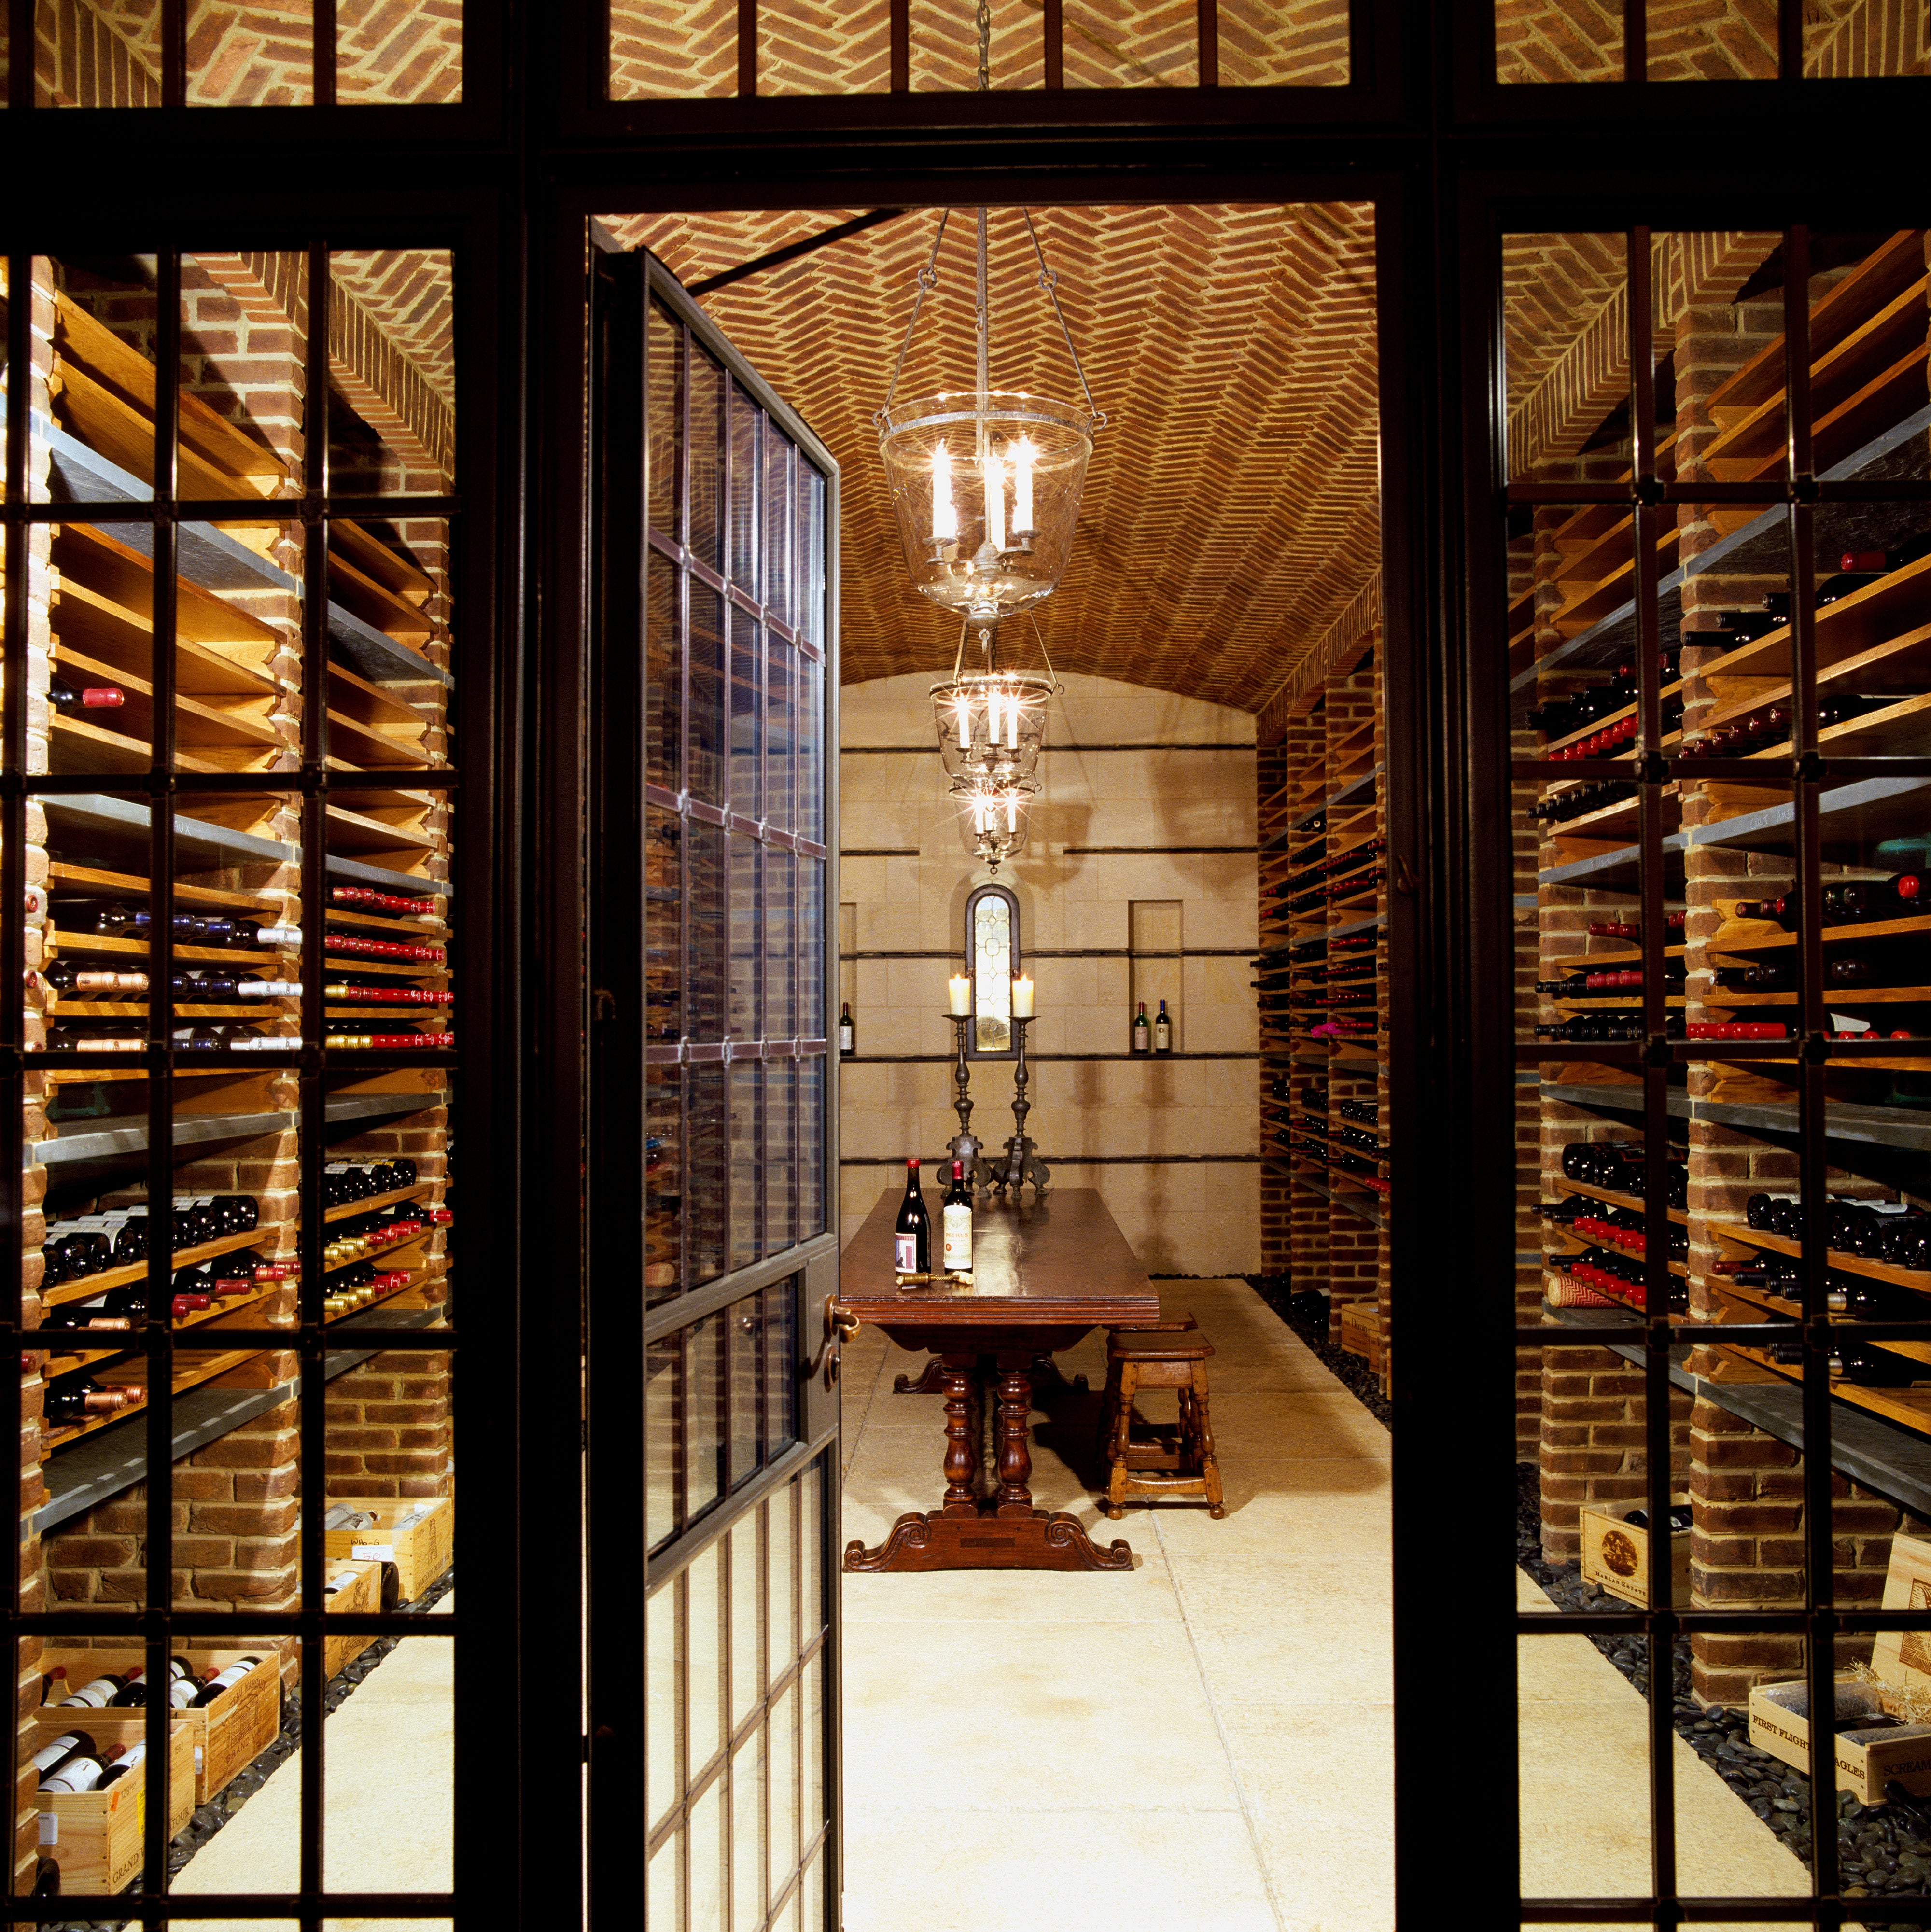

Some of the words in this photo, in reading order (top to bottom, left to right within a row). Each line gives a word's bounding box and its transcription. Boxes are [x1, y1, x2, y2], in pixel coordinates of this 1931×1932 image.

[1595, 1571, 1620, 1585] HARLAN
[1622, 1581, 1646, 1596] ESTATE
[1752, 1714, 1778, 1734] FIRST
[1779, 1728, 1810, 1751] FLIGHT
[1834, 1757, 1865, 1780] AGLES
[113, 1853, 139, 1883] GRAND
